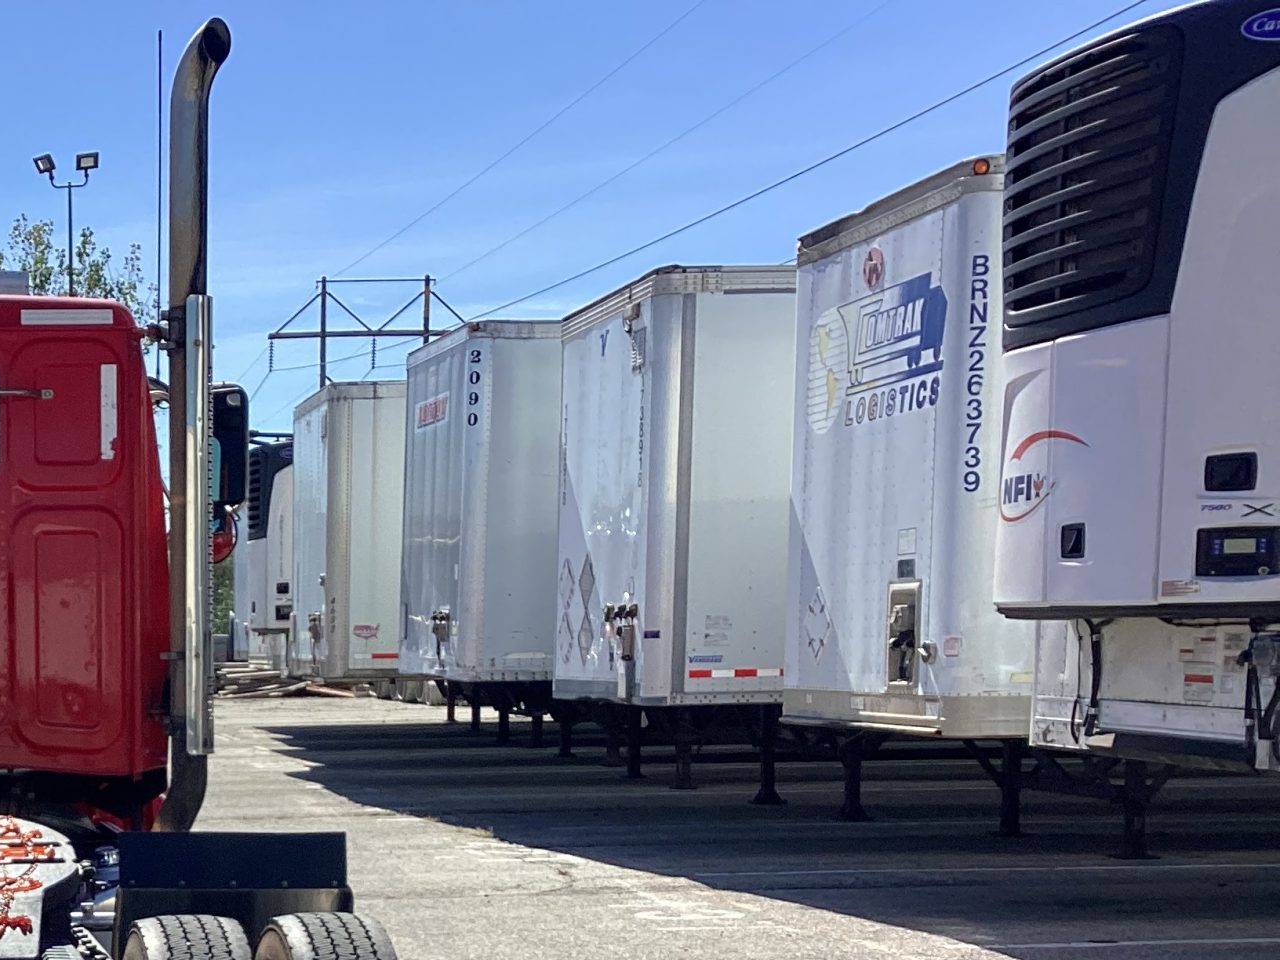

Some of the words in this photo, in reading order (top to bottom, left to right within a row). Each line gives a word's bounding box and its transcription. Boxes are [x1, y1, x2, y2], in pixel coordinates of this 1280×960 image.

[467, 349, 482, 427] 2090
[843, 375, 942, 428] LOGISTICS
[963, 254, 990, 493] BRNZ263739
[1003, 473, 1033, 505] NFI
